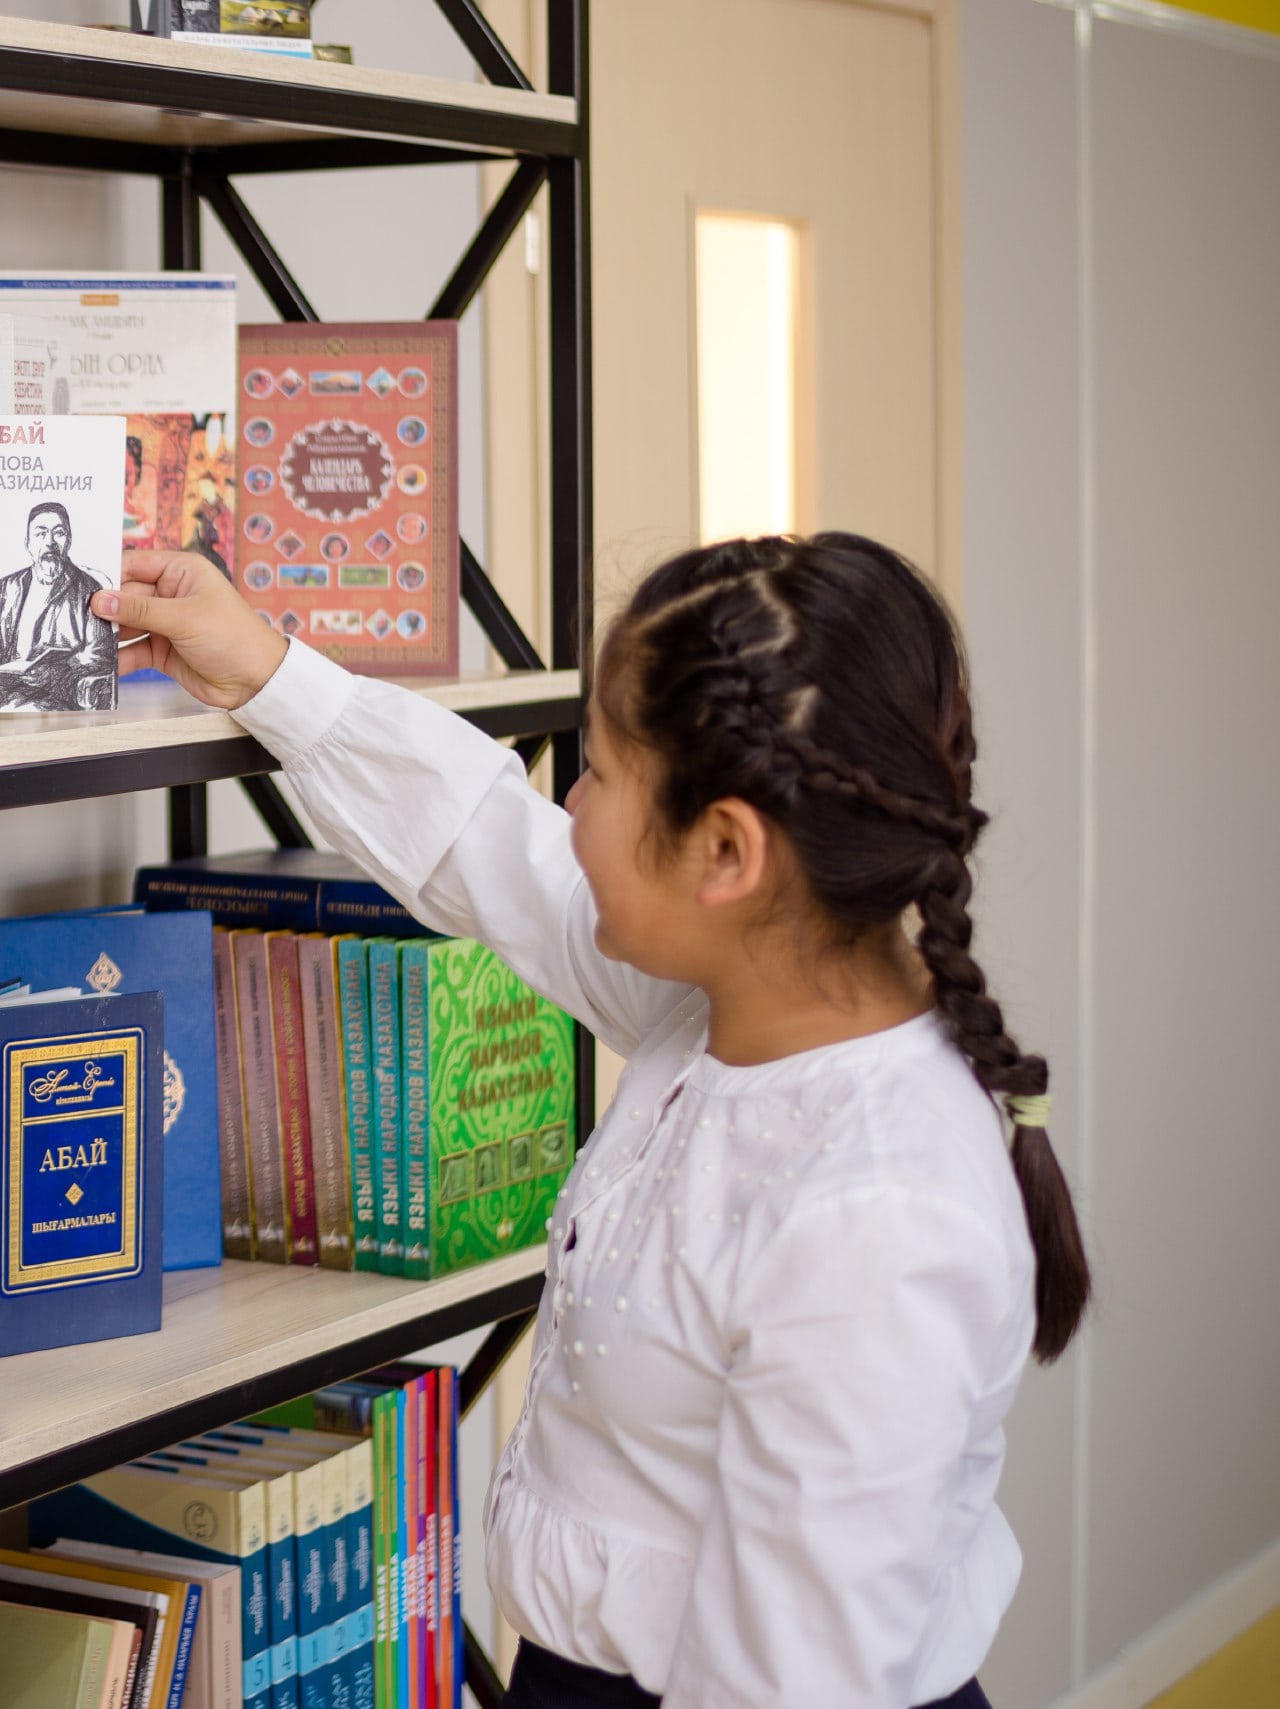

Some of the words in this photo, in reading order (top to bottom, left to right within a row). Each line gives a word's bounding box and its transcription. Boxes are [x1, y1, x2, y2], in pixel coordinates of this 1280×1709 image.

[345, 959, 365, 1064] КАЗАХСТАНА
[376, 962, 394, 1068] КАЗАХСТАНА
[407, 965, 424, 1070] КАЗАХСТАНА
[469, 1032, 541, 1071] НАРОДОВ
[351, 1069, 369, 1148] НАРОДОВ
[379, 1072, 397, 1152] НАРОДОВ
[408, 1075, 425, 1156] НАРОДОВ
[458, 1066, 554, 1112] КАЗАХСТАНА
[39, 1137, 108, 1173] АБАЙ
[355, 1153, 374, 1222] ЯЗЫКИ
[31, 1212, 116, 1235] ШЫҒАРМАЛАРЫ
[382, 1157, 400, 1226] ЯЗЫКИ
[409, 1161, 426, 1230] ЯЗЫКИ
[334, 1625, 346, 1651] 2
[358, 1613, 369, 1638] 3
[254, 1661, 264, 1687] 5
